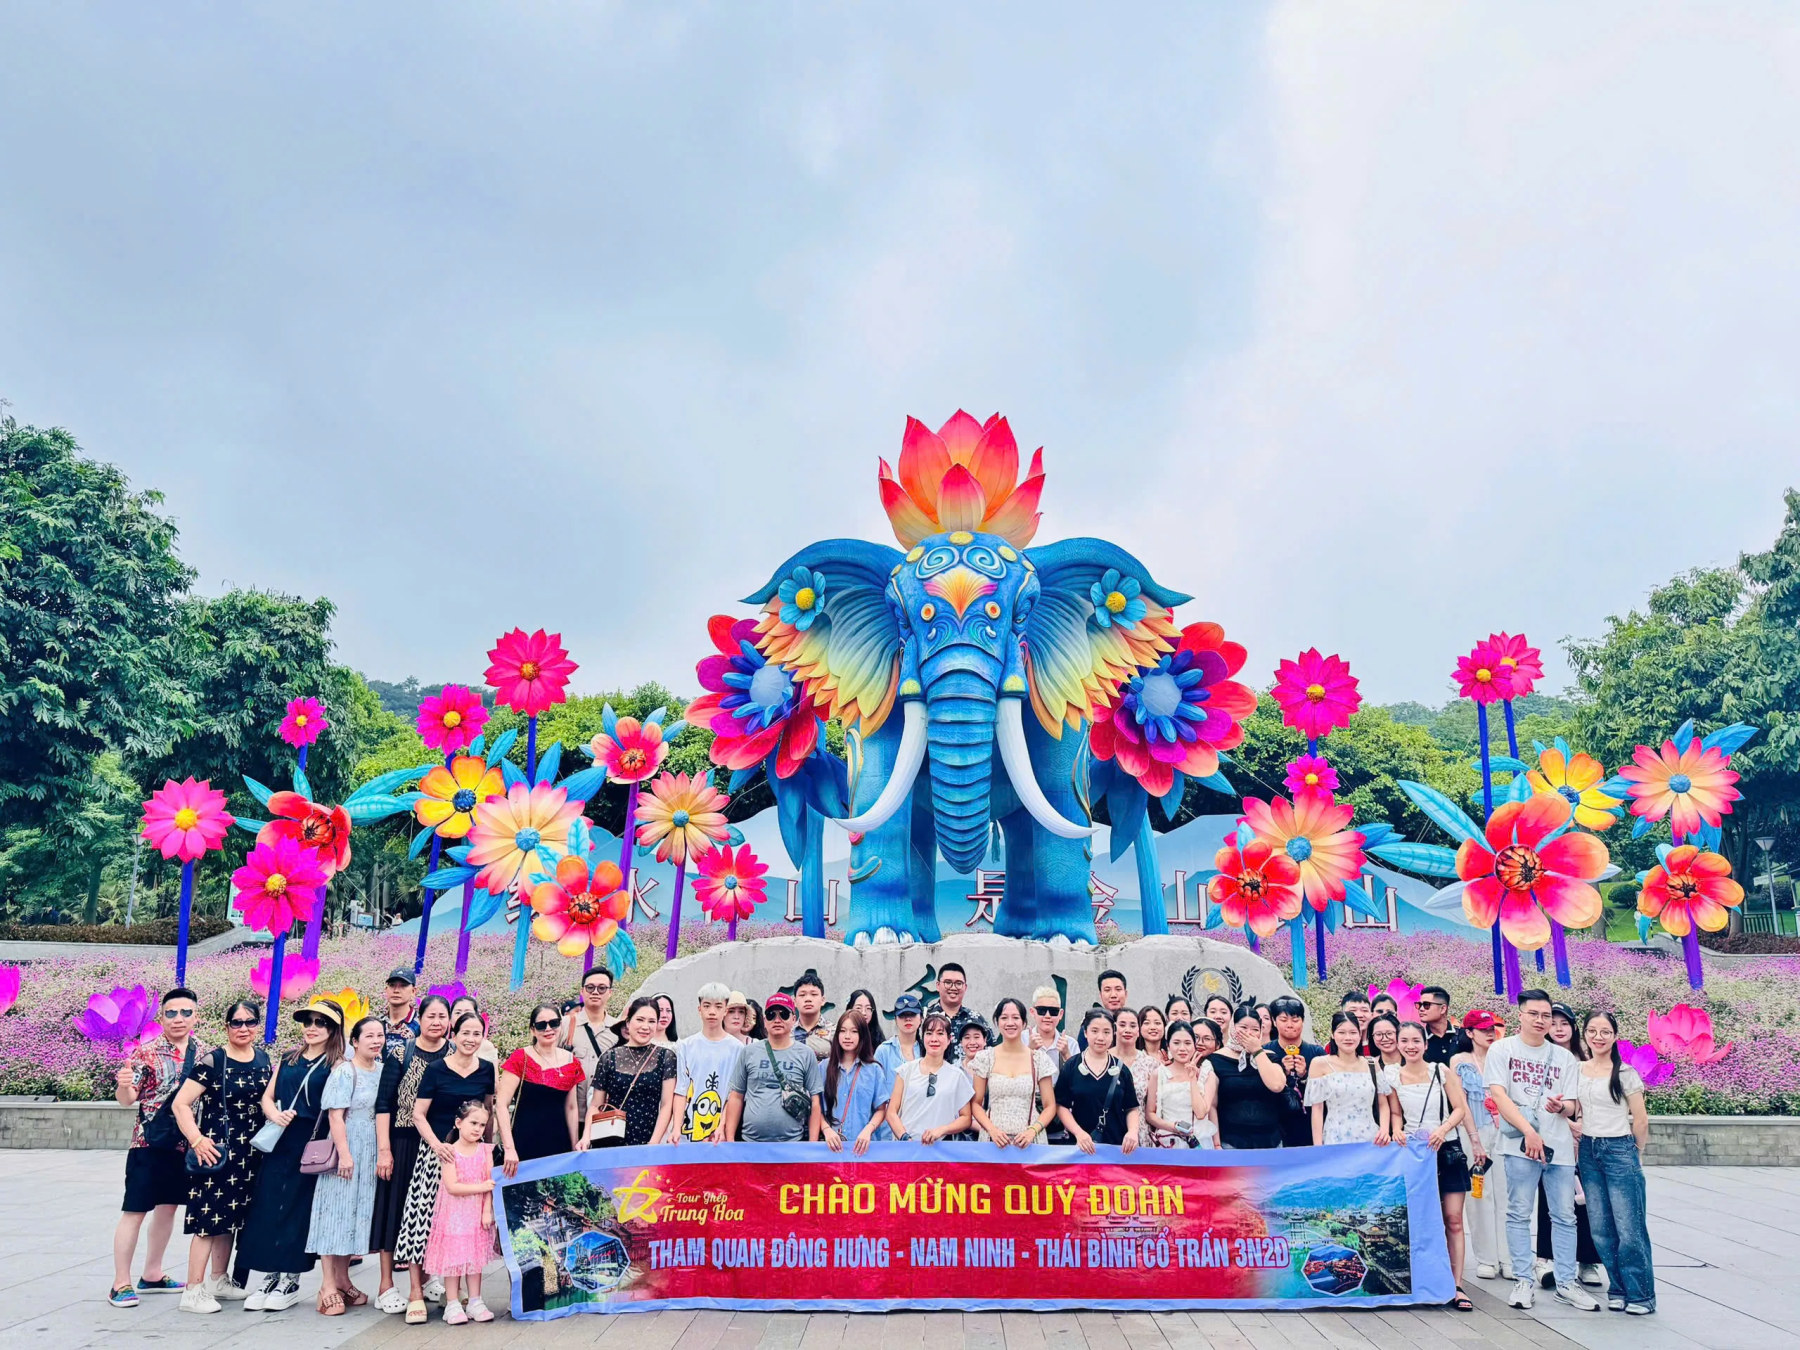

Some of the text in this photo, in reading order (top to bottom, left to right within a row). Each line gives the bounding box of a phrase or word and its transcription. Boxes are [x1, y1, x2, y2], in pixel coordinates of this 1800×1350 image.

[676, 1190, 728, 1205] Tour Ghép
[779, 1176, 1185, 1216] CHÀO MỪNG QUÝ ĐOÀN
[660, 1203, 745, 1226] Trung Hoa
[648, 1237, 706, 1270] THAM
[711, 1237, 765, 1270] QUAN
[770, 1231, 828, 1268] ĐÔNG
[833, 1234, 890, 1268] HƯNG
[910, 1237, 958, 1268] NAM
[964, 1237, 1016, 1268] NINH
[1034, 1232, 1081, 1268] THÁI
[1087, 1232, 1137, 1268] BÌNH
[1142, 1226, 1171, 1269] CỔ
[1174, 1227, 1230, 1268] TRẤN
[1234, 1236, 1291, 1269] 3N2Đ
